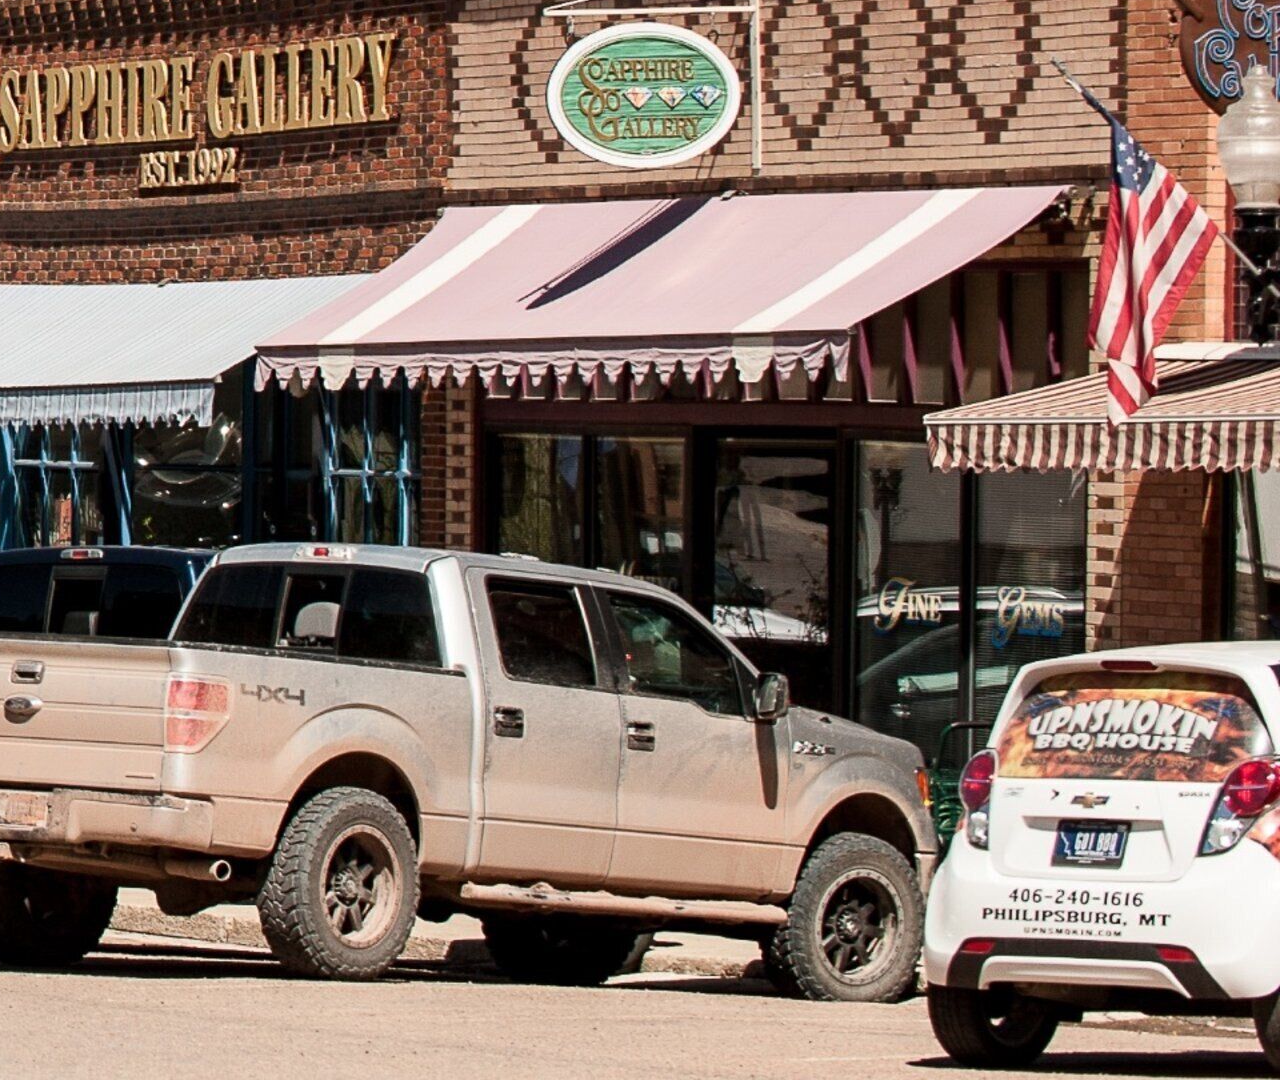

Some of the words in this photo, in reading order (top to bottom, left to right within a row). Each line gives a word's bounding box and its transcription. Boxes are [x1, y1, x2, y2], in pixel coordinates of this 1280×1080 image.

[0, 56, 195, 153] SAPPHIRE
[207, 32, 396, 139] GALLERY
[589, 113, 703, 141] GALLERY
[186, 147, 237, 185] 1992
[874, 577, 942, 631] FINE
[992, 586, 1065, 648] GEMS
[1028, 699, 1218, 740] UPNSMOKIN
[1034, 733, 1091, 751] BBQ
[1095, 733, 1195, 753] HOUSE
[1009, 888, 1144, 908] 406-240-1616
[1139, 913, 1171, 927] MT
